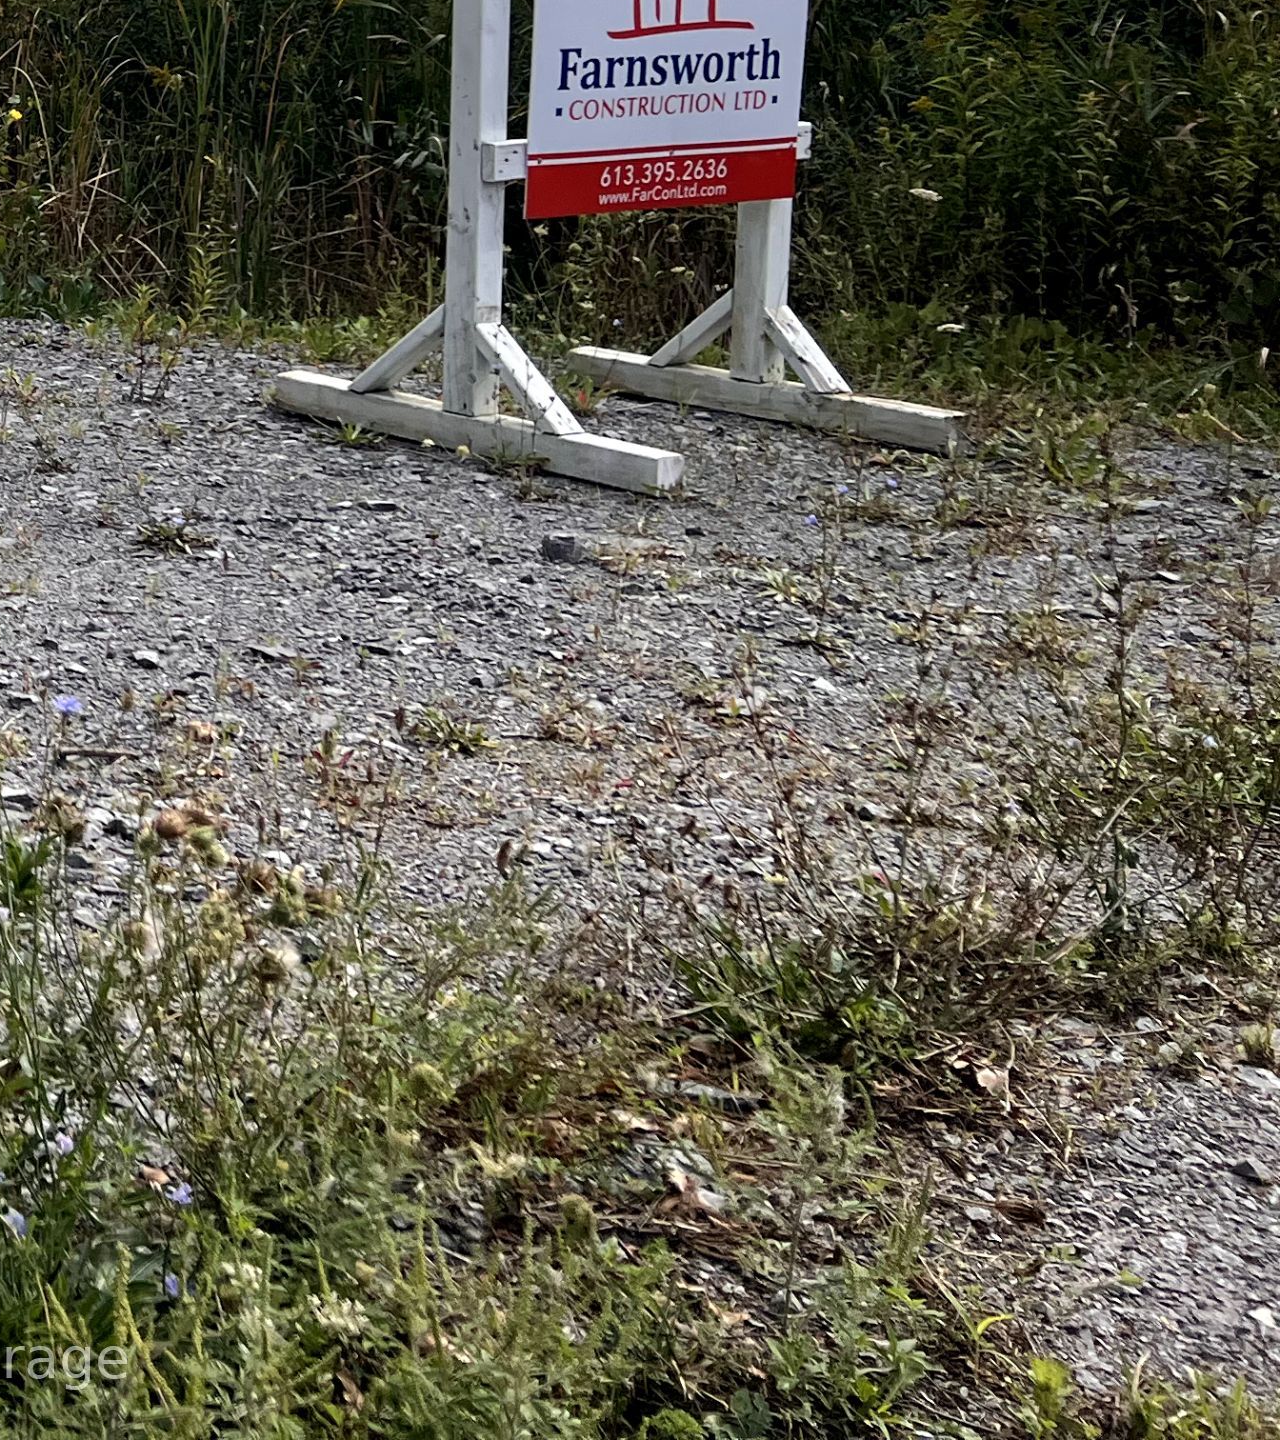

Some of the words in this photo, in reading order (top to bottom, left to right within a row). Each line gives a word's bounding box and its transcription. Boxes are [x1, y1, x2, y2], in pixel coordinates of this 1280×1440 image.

[557, 38, 781, 91] Farnsworth
[568, 93, 726, 121] CONSTRUCTION
[734, 90, 767, 111] LTD
[600, 158, 728, 188] 613.395.2636
[598, 183, 727, 206] www.FarConLtd.com
